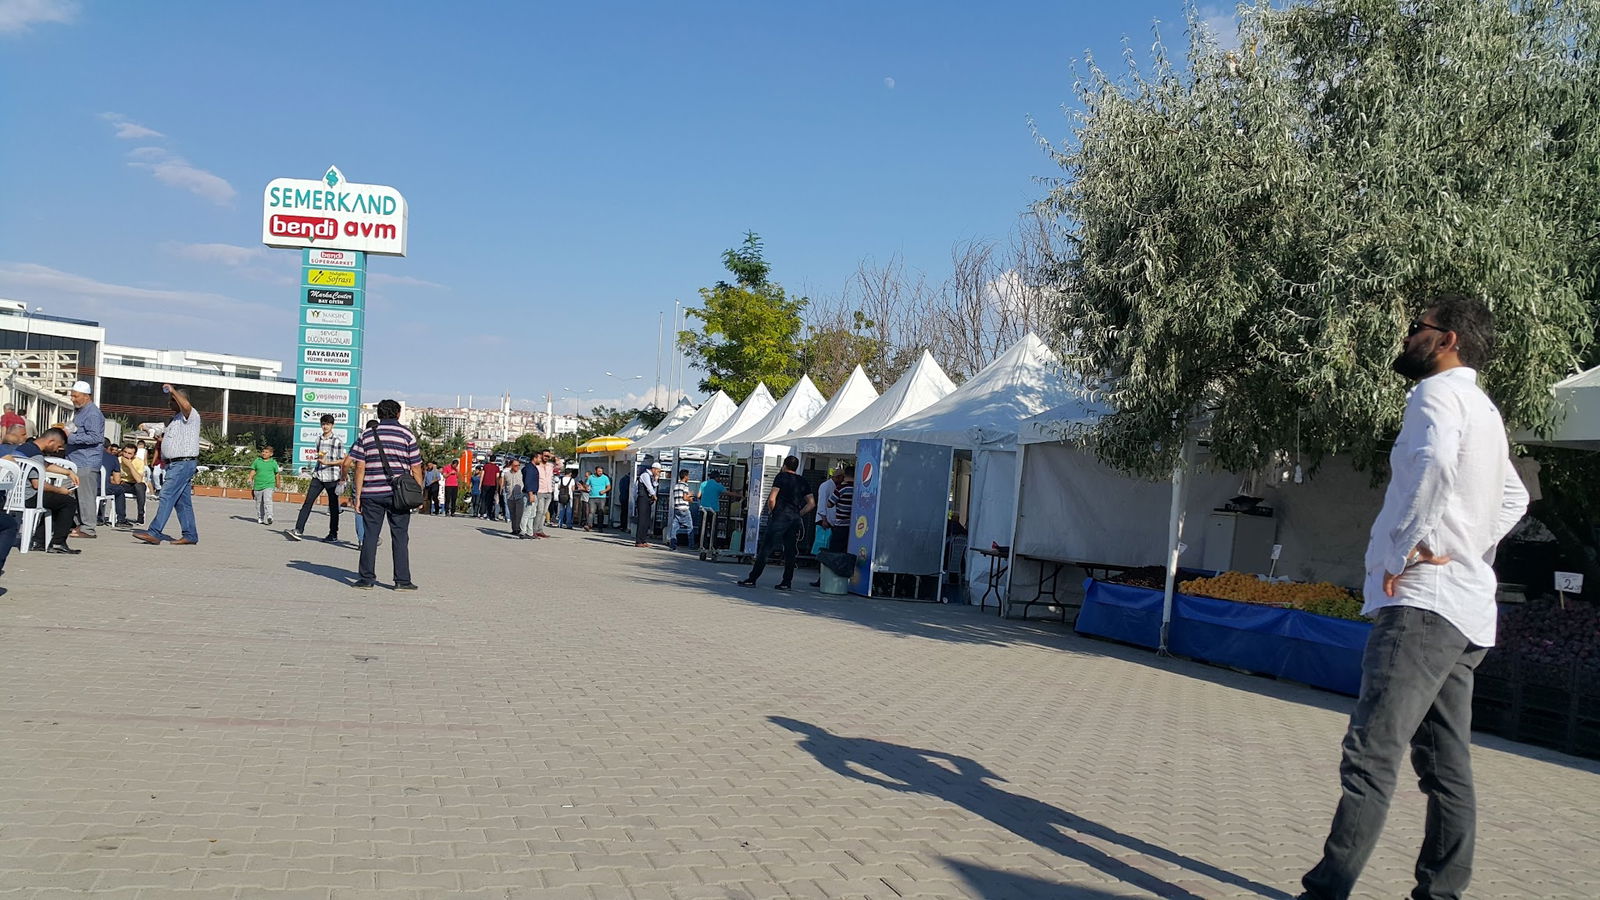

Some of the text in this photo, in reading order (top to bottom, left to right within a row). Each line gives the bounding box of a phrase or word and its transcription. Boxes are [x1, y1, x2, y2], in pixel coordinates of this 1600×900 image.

[270, 187, 396, 215] SEMERKAND
[273, 216, 396, 239] bendi avm
[307, 350, 349, 358] BAY&BAYAN
